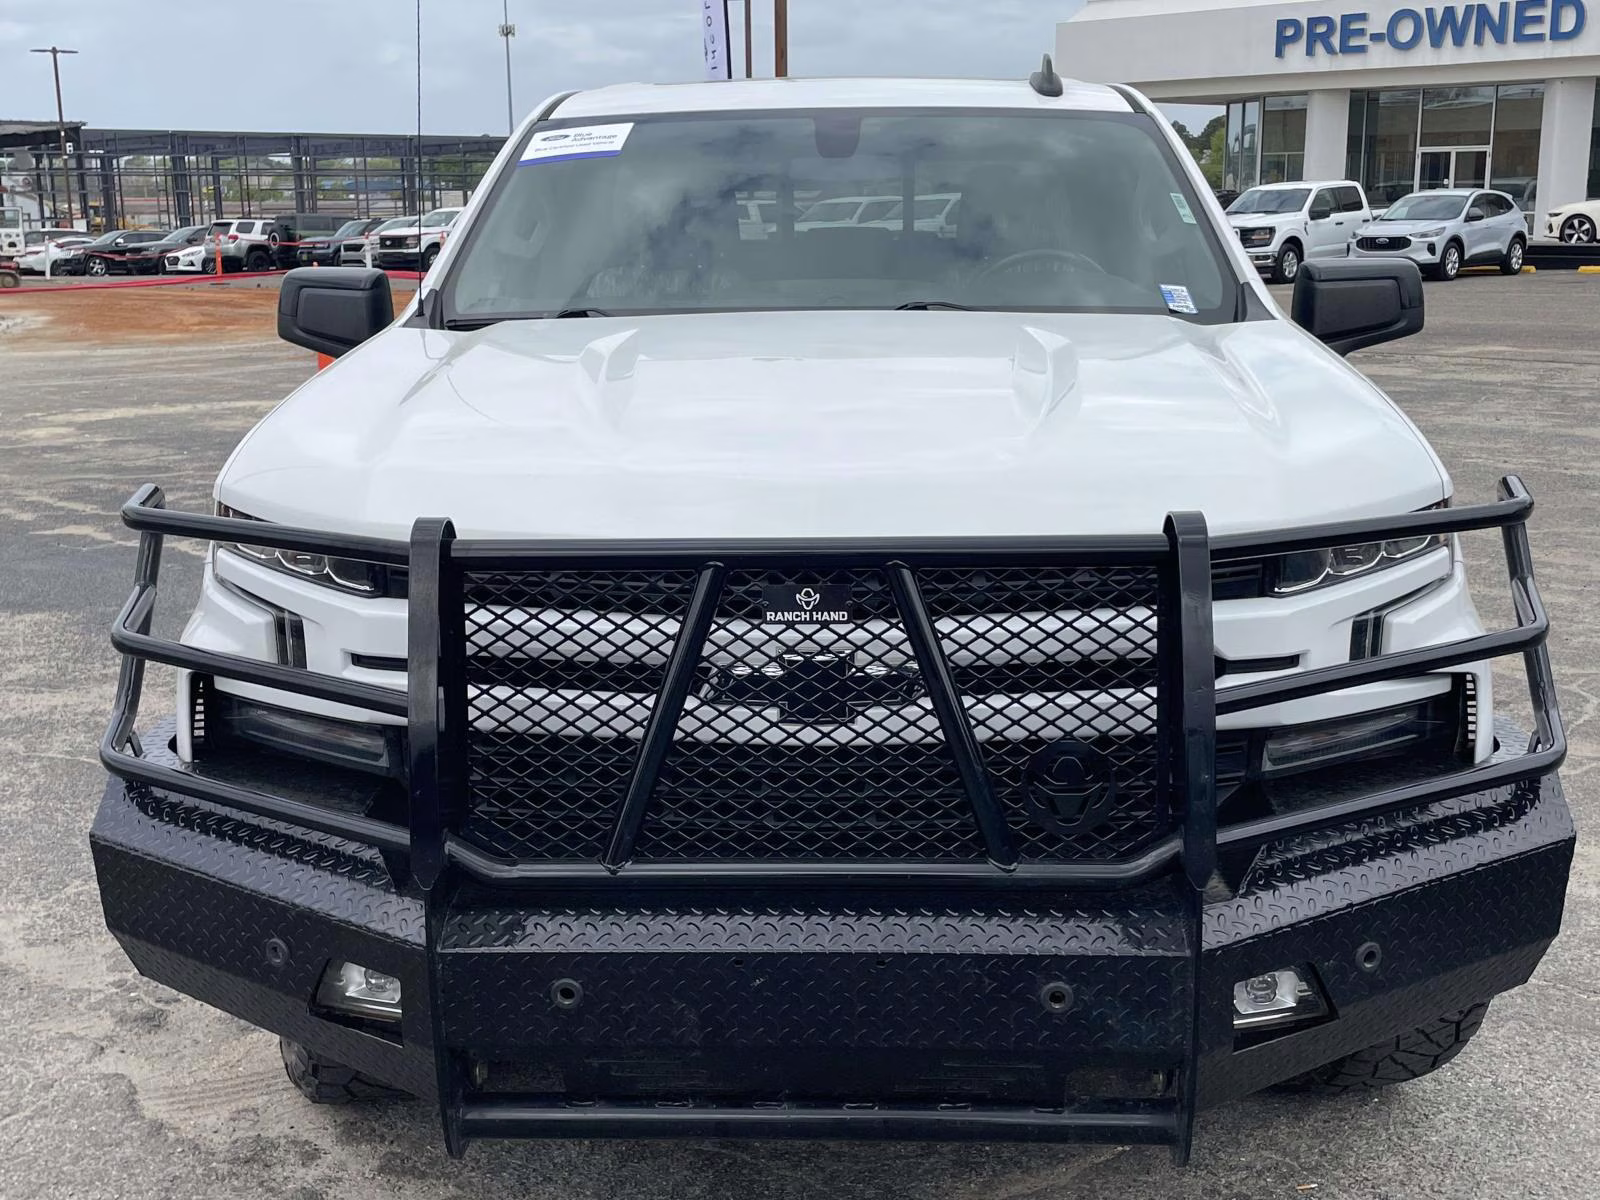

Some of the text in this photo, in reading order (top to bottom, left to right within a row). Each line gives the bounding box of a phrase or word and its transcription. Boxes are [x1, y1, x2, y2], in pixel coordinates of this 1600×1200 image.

[1275, 0, 1587, 58] PRE-OWNED
[766, 611, 848, 621] RANCH HAND
